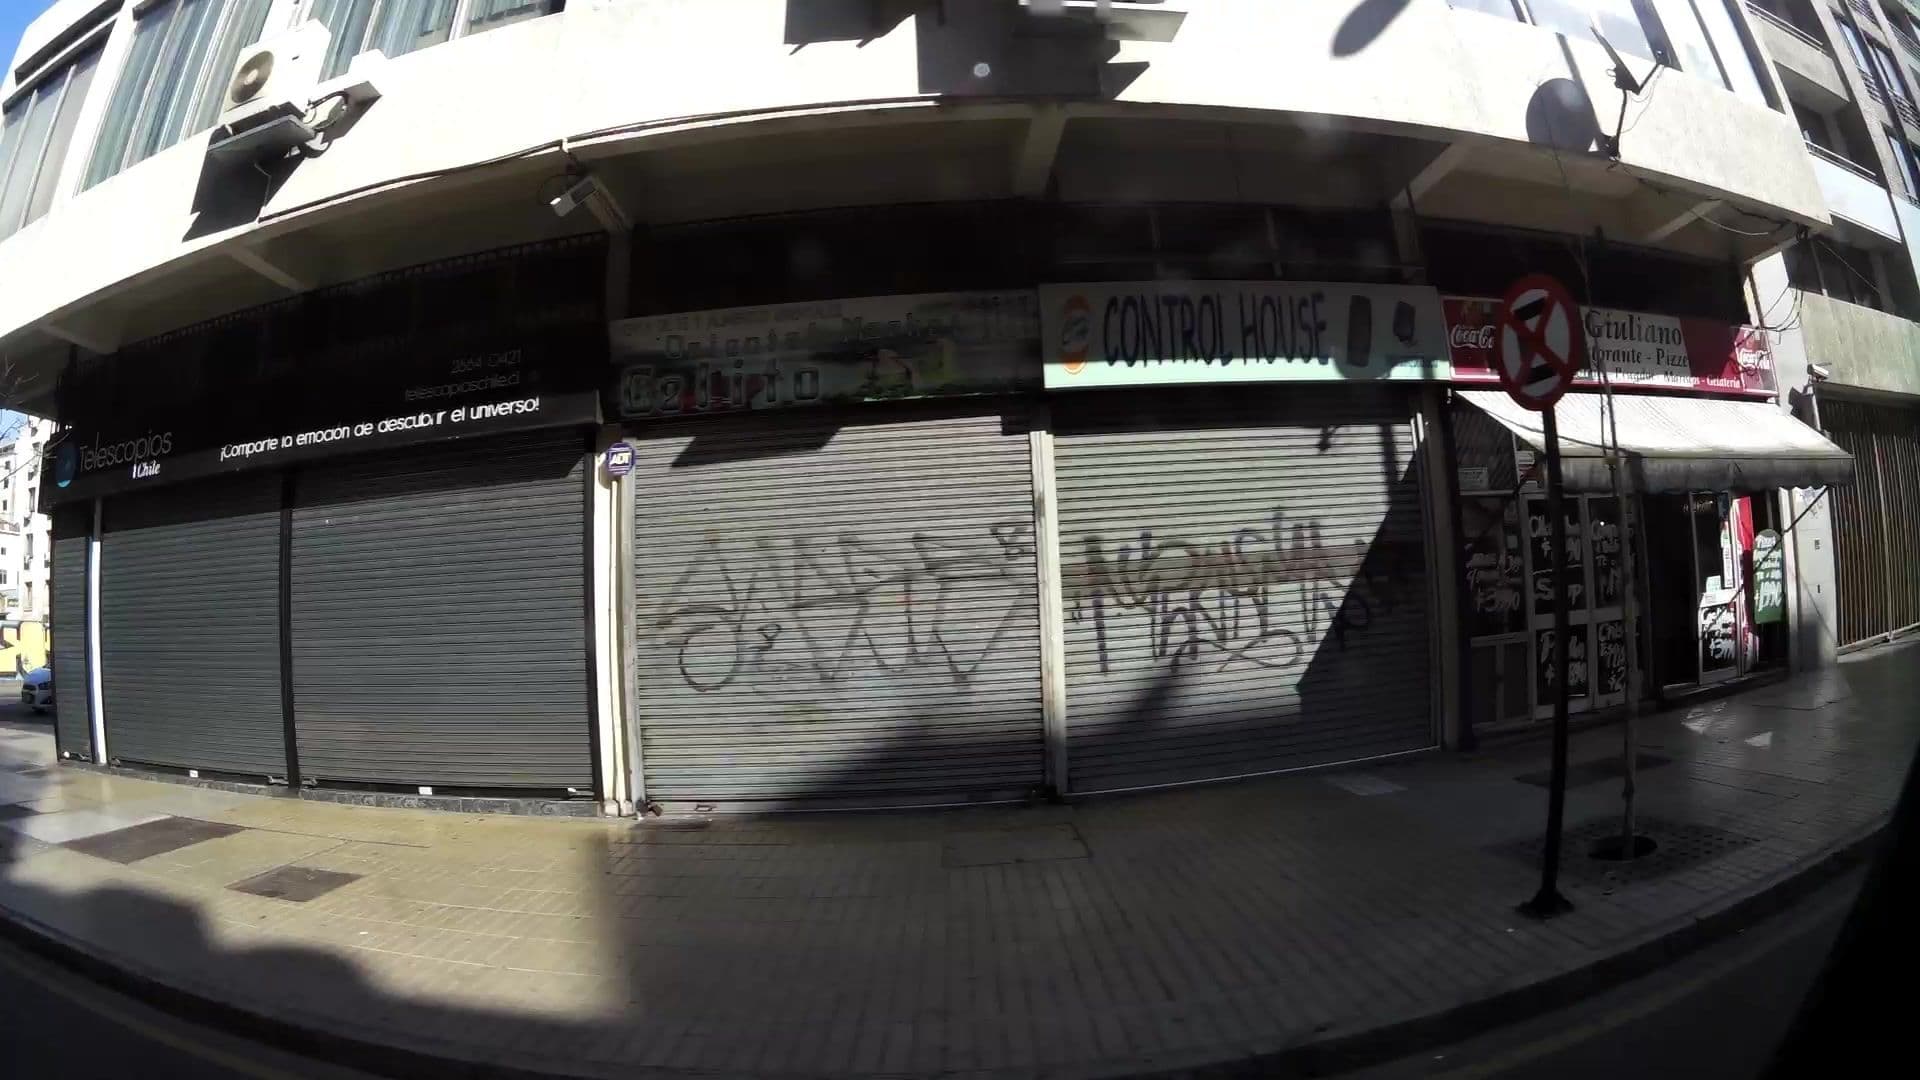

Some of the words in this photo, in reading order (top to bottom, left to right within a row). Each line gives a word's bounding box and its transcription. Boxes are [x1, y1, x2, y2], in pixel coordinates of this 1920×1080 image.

[1103, 294, 1233, 367] CONTROL
[1239, 292, 1330, 366] HOUSE
[1585, 309, 1682, 345] Giuliano
[281, 435, 293, 448] la
[353, 422, 374, 437] de
[450, 406, 465, 423] el
[469, 396, 541, 420] universo!
[79, 431, 174, 473] Telescopios
[137, 460, 161, 478] Chile
[610, 452, 632, 466] ADT
